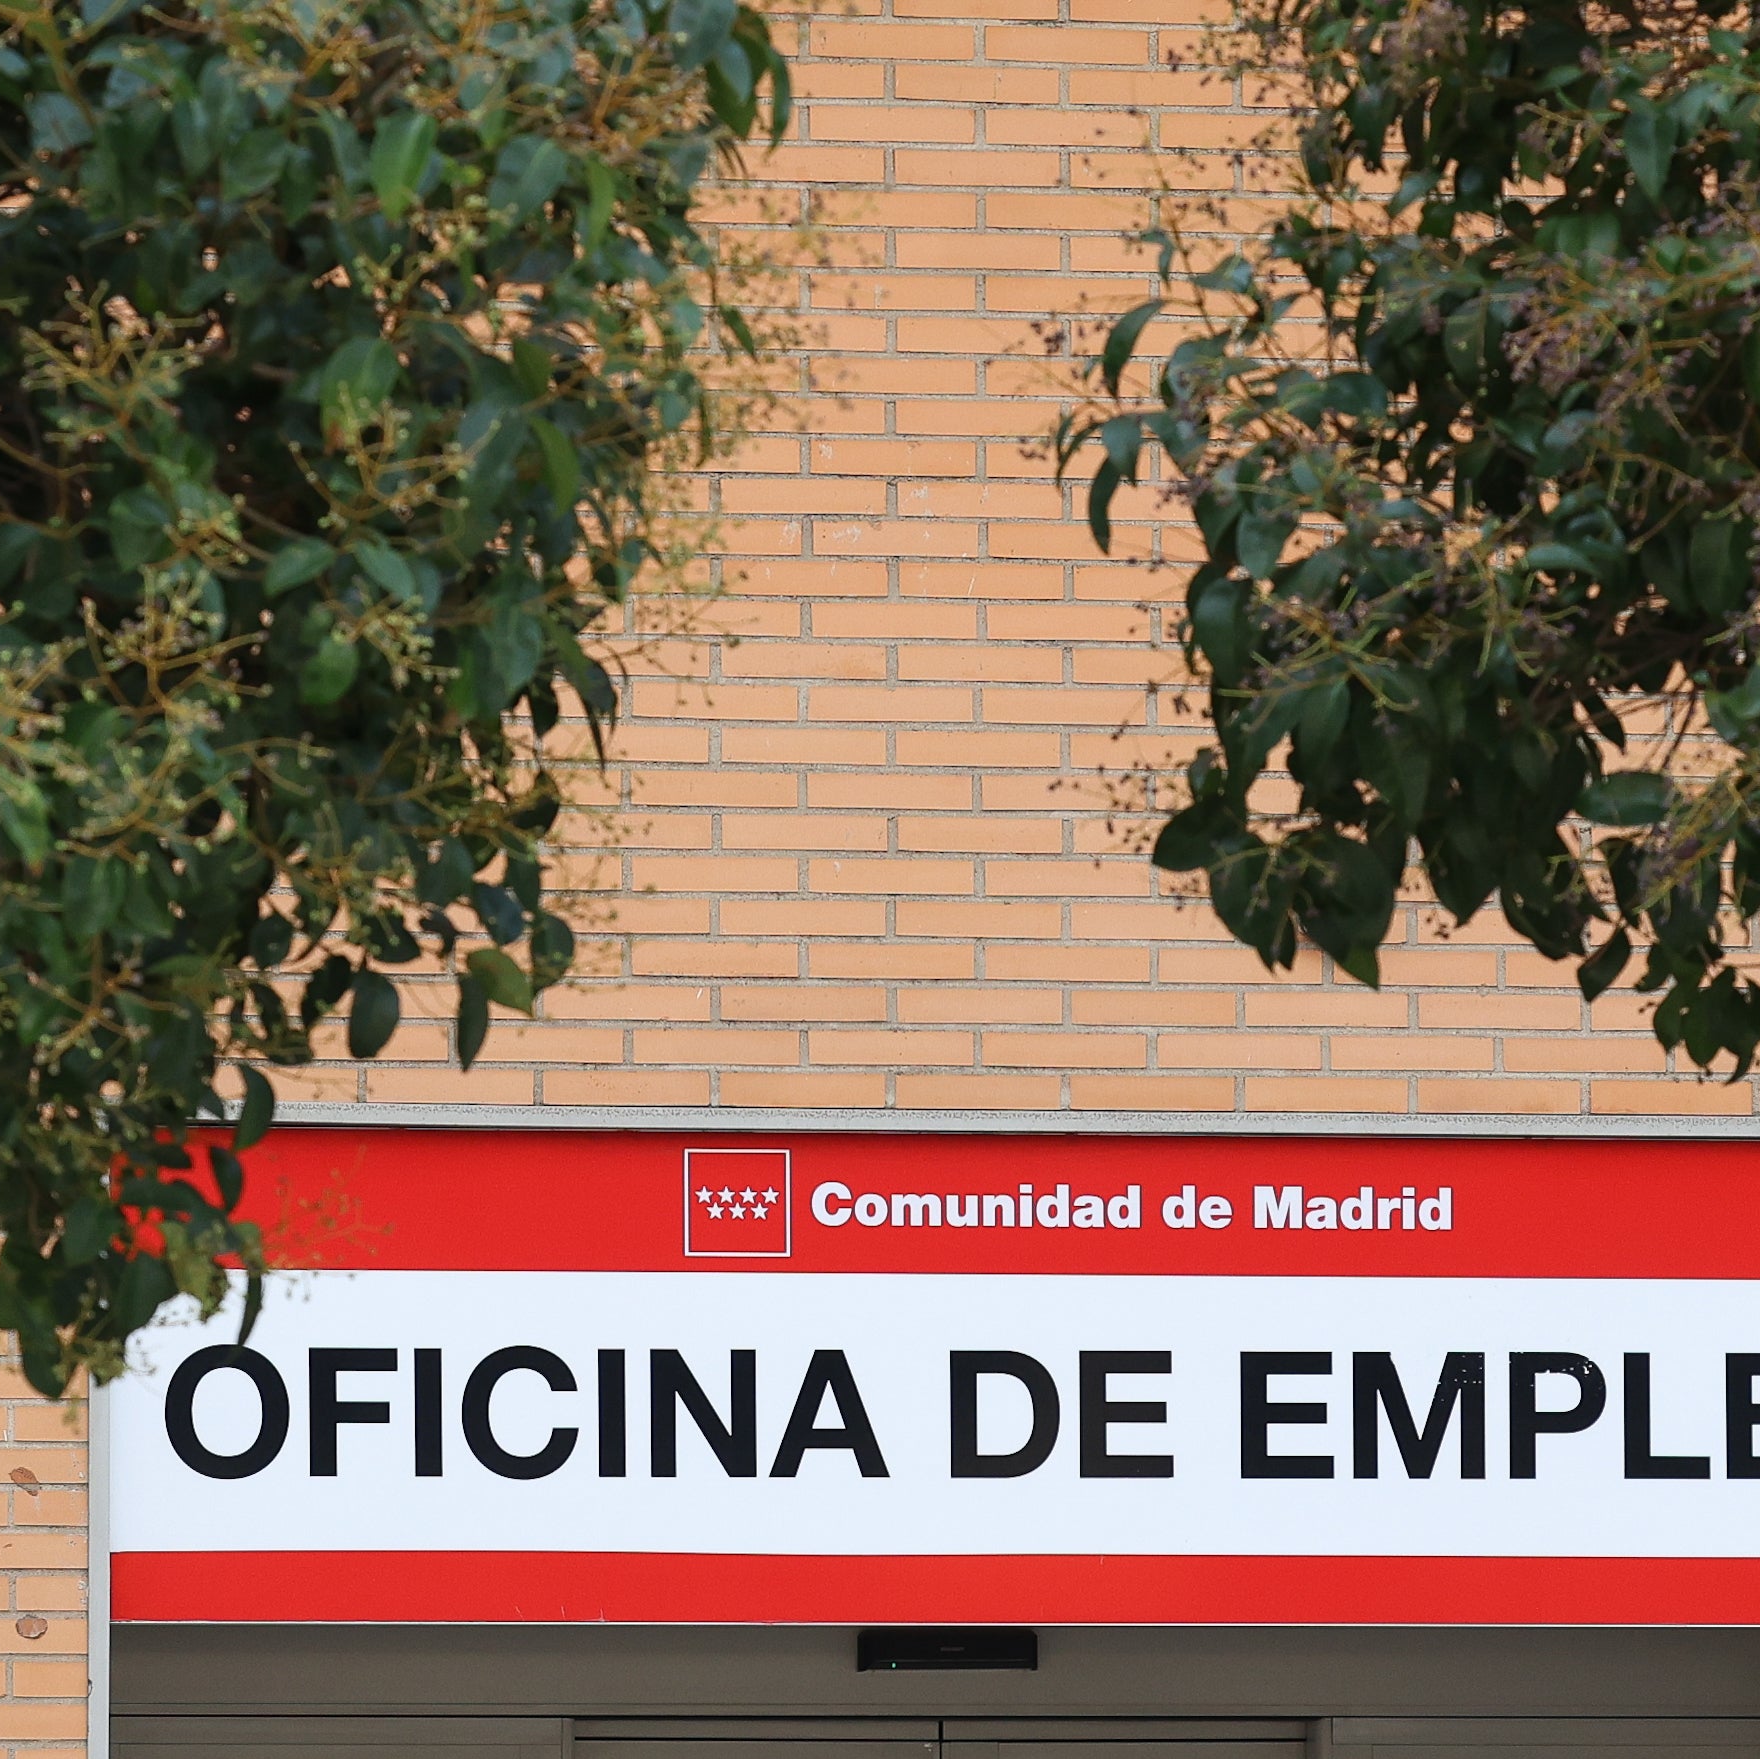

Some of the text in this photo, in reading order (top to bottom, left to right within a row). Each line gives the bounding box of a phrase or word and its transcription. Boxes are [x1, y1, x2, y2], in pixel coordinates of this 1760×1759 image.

[811, 1181, 1453, 1231] Comunidad de Madrid
[165, 1343, 890, 1480] OFICINA
[949, 1349, 1174, 1480] DE
